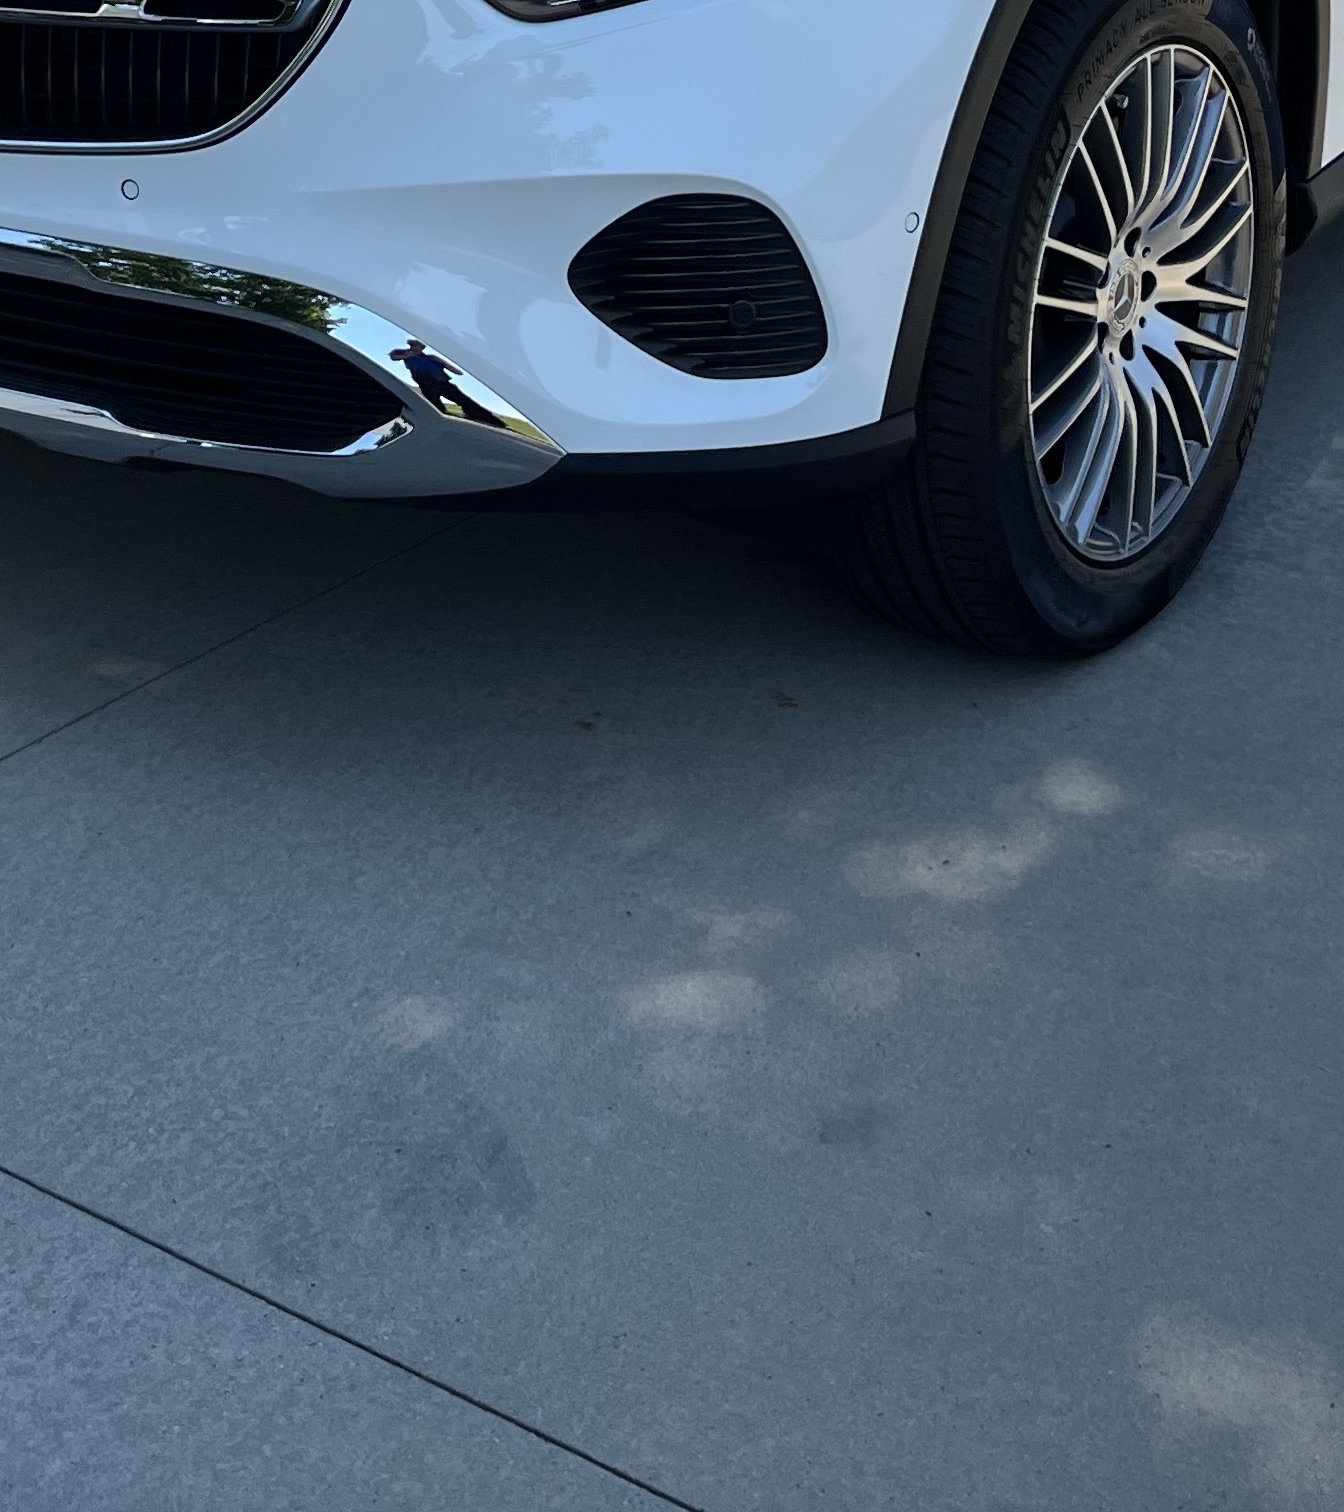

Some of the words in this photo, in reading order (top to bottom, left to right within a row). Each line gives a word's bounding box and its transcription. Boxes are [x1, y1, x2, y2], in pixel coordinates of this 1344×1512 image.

[1075, 18, 1128, 100] PRIMACY
[1135, 0, 1156, 24] ALL
[1007, 120, 1068, 345] MICHELIN
